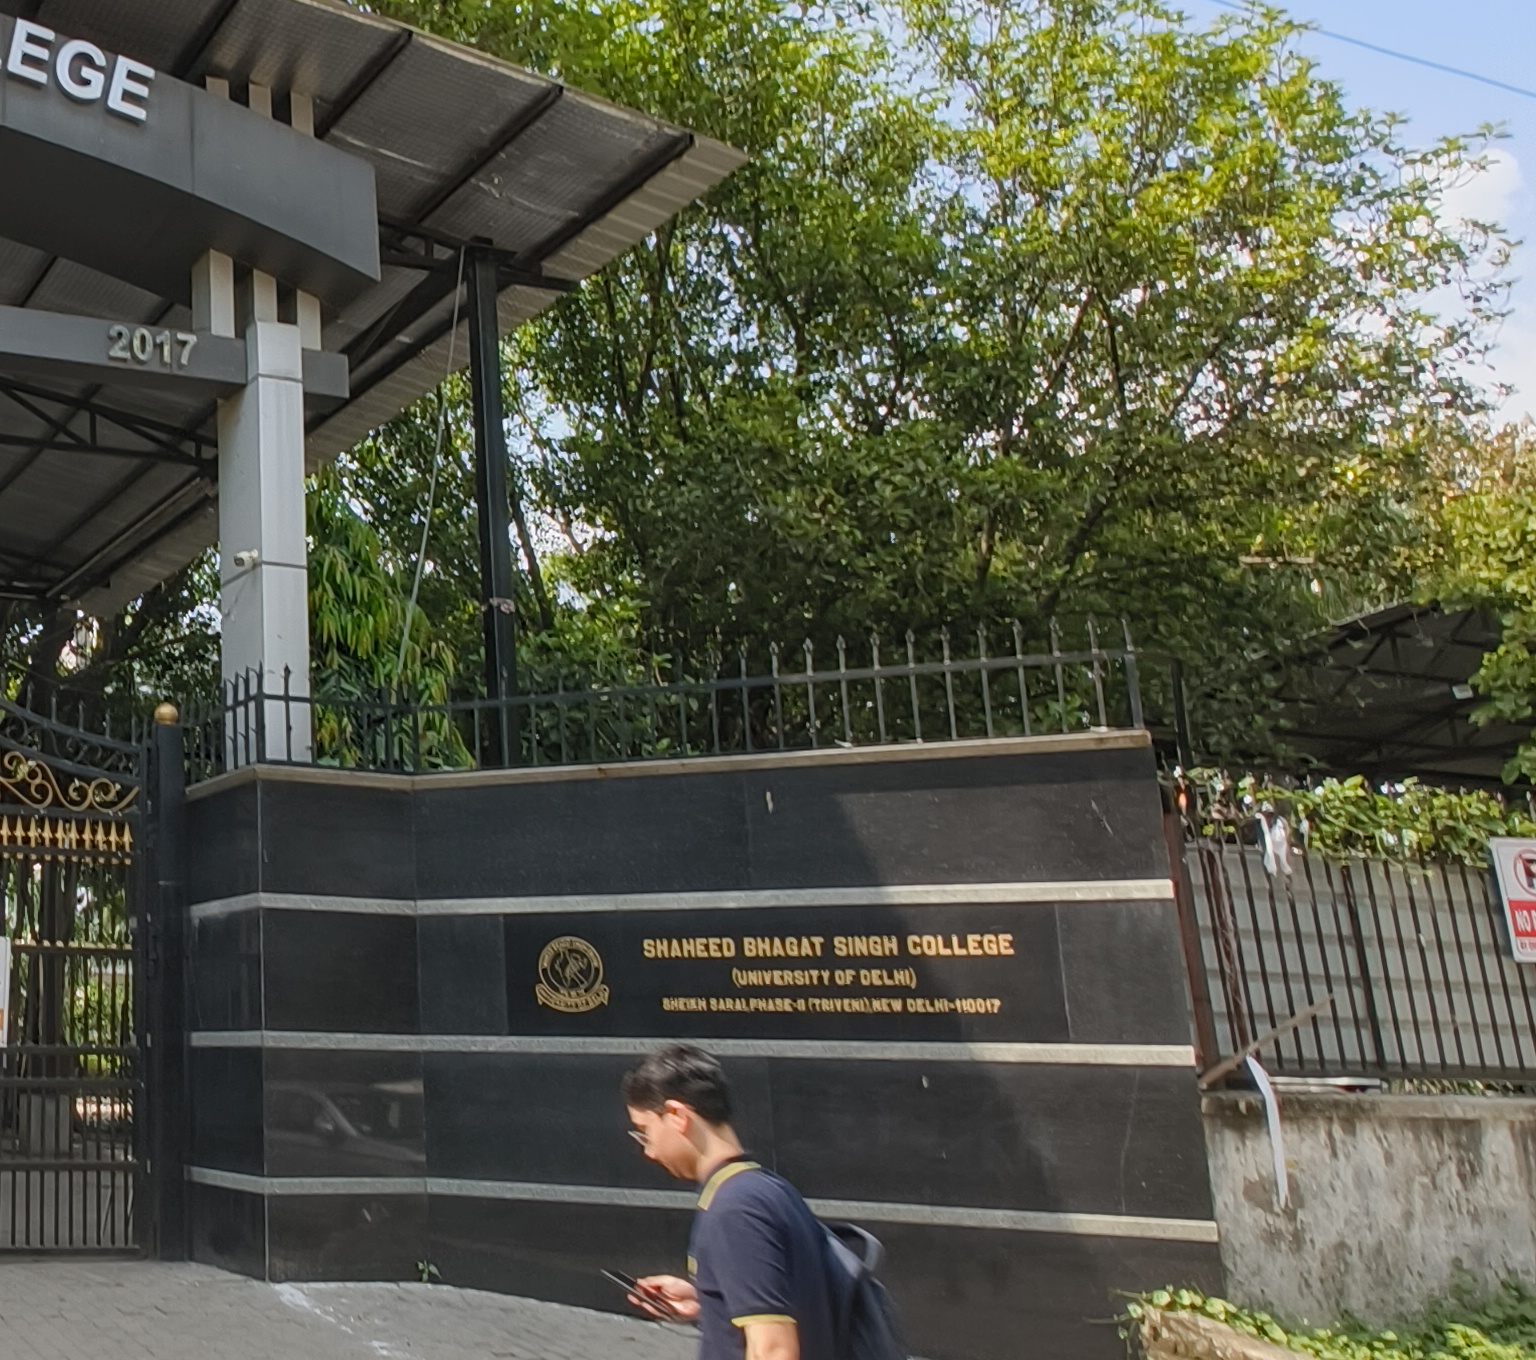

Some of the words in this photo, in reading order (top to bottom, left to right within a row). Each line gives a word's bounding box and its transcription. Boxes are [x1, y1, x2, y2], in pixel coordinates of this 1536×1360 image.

[109, 325, 198, 366] 2017
[643, 937, 736, 959] SHAHEED
[743, 935, 825, 958] BHAGAT
[833, 935, 899, 957] SINGH
[906, 933, 1015, 956] COLLEGE
[732, 967, 830, 989] (UNIVERSITY
[834, 969, 856, 986] OF
[860, 966, 917, 990] DELHI)
